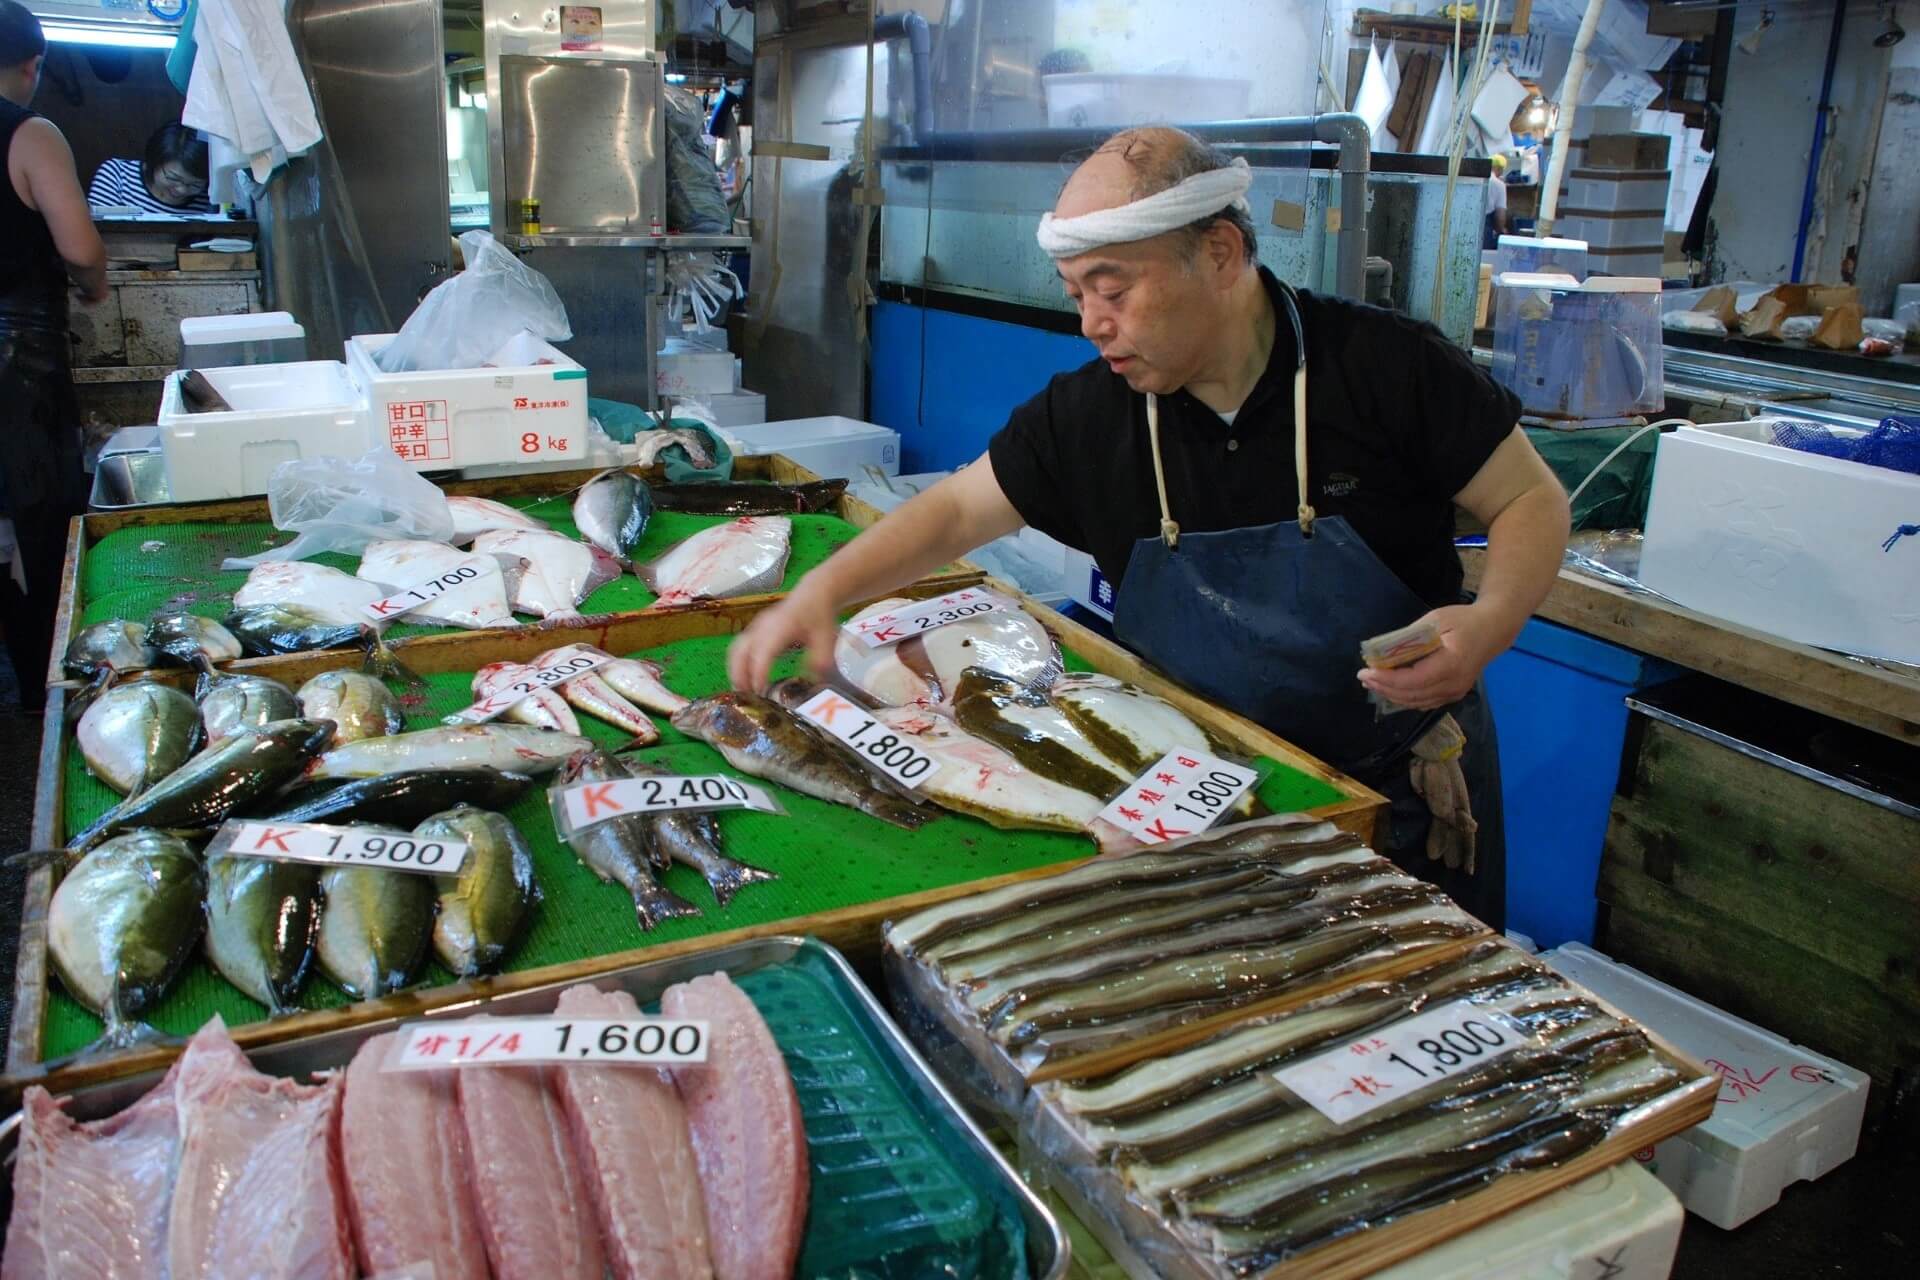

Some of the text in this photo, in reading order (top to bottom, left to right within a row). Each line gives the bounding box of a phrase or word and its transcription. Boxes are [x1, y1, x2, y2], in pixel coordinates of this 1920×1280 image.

[390, 403, 425, 420] 甘口
[391, 423, 425, 440] 中辛
[394, 443, 427, 459] 辛口
[521, 432, 568, 453] 8 kg
[370, 566, 478, 615] K 1,700
[873, 602, 993, 642] K 2,300
[474, 656, 594, 715] K 2,800
[809, 696, 931, 778] K 1,800
[583, 778, 749, 818] K 2,400
[1144, 770, 1243, 841] K 1,800
[254, 827, 444, 866] K 1,900
[554, 1023, 701, 1057] 1,600
[1387, 1019, 1505, 1078] 1,800
